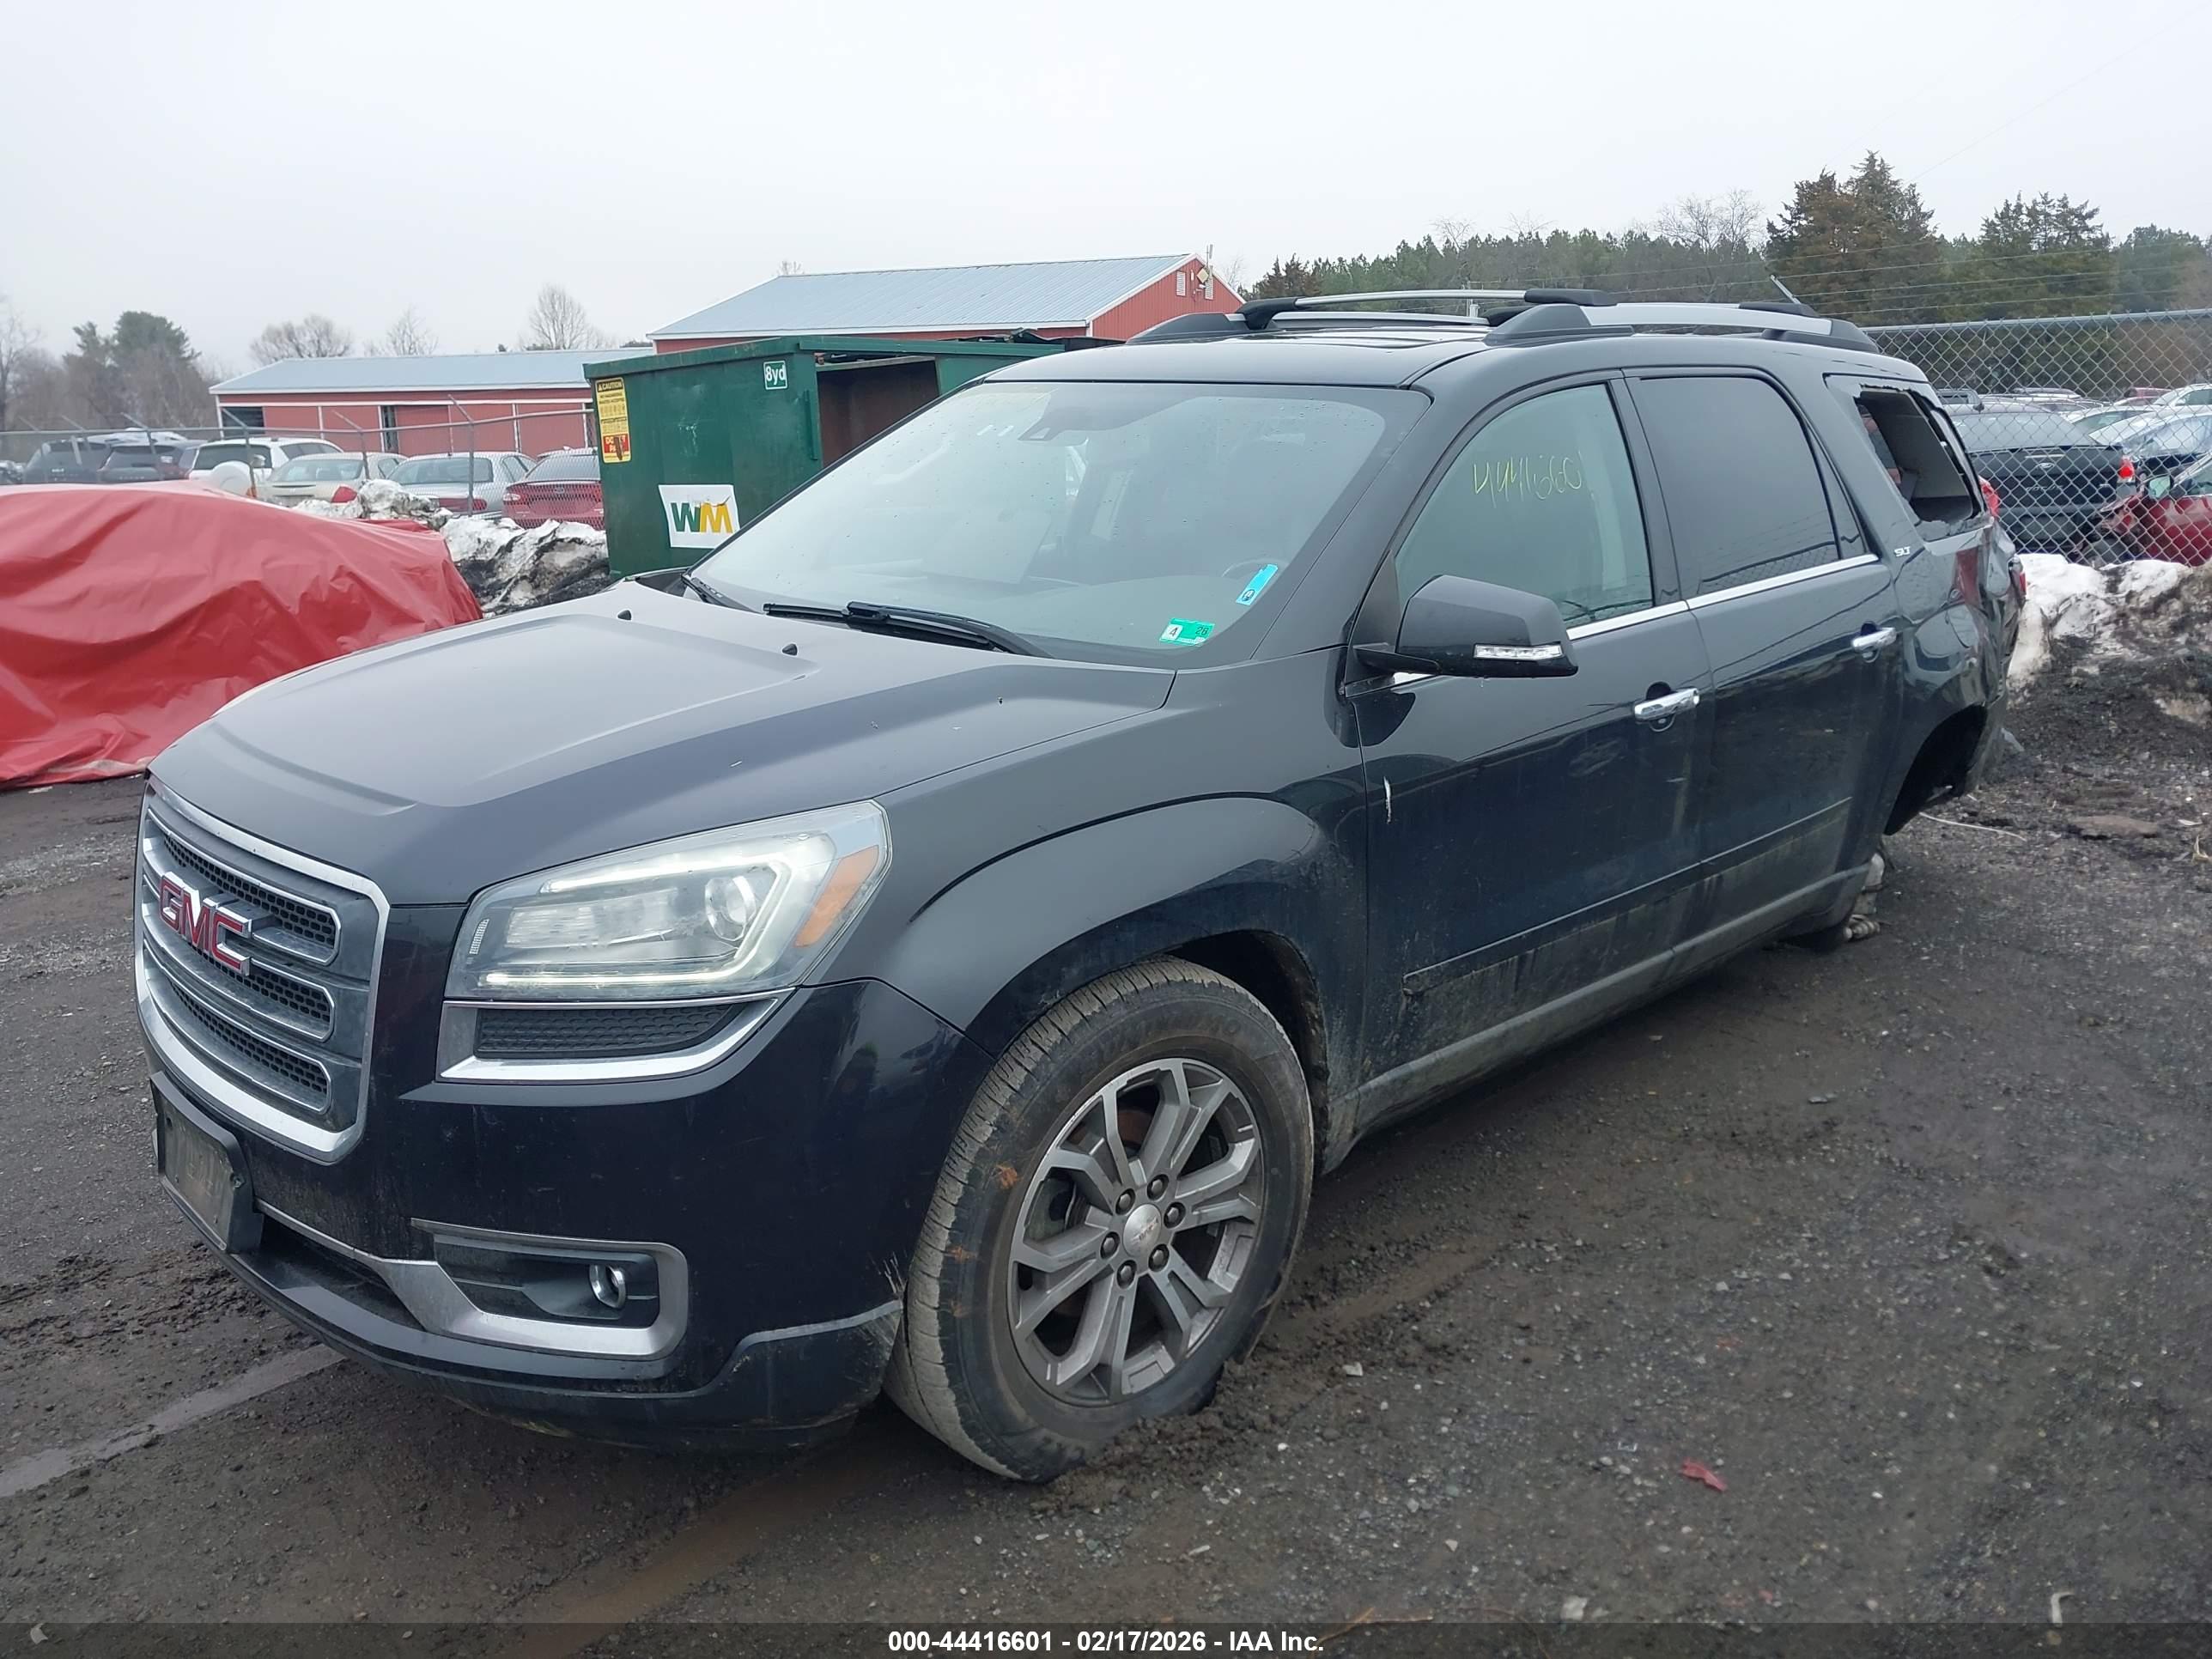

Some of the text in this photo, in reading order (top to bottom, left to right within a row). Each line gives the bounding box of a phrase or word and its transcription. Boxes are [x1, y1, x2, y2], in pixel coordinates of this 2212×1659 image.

[765, 365, 786, 385] 8yd
[671, 501, 733, 533] WM
[160, 872, 252, 975] GMC
